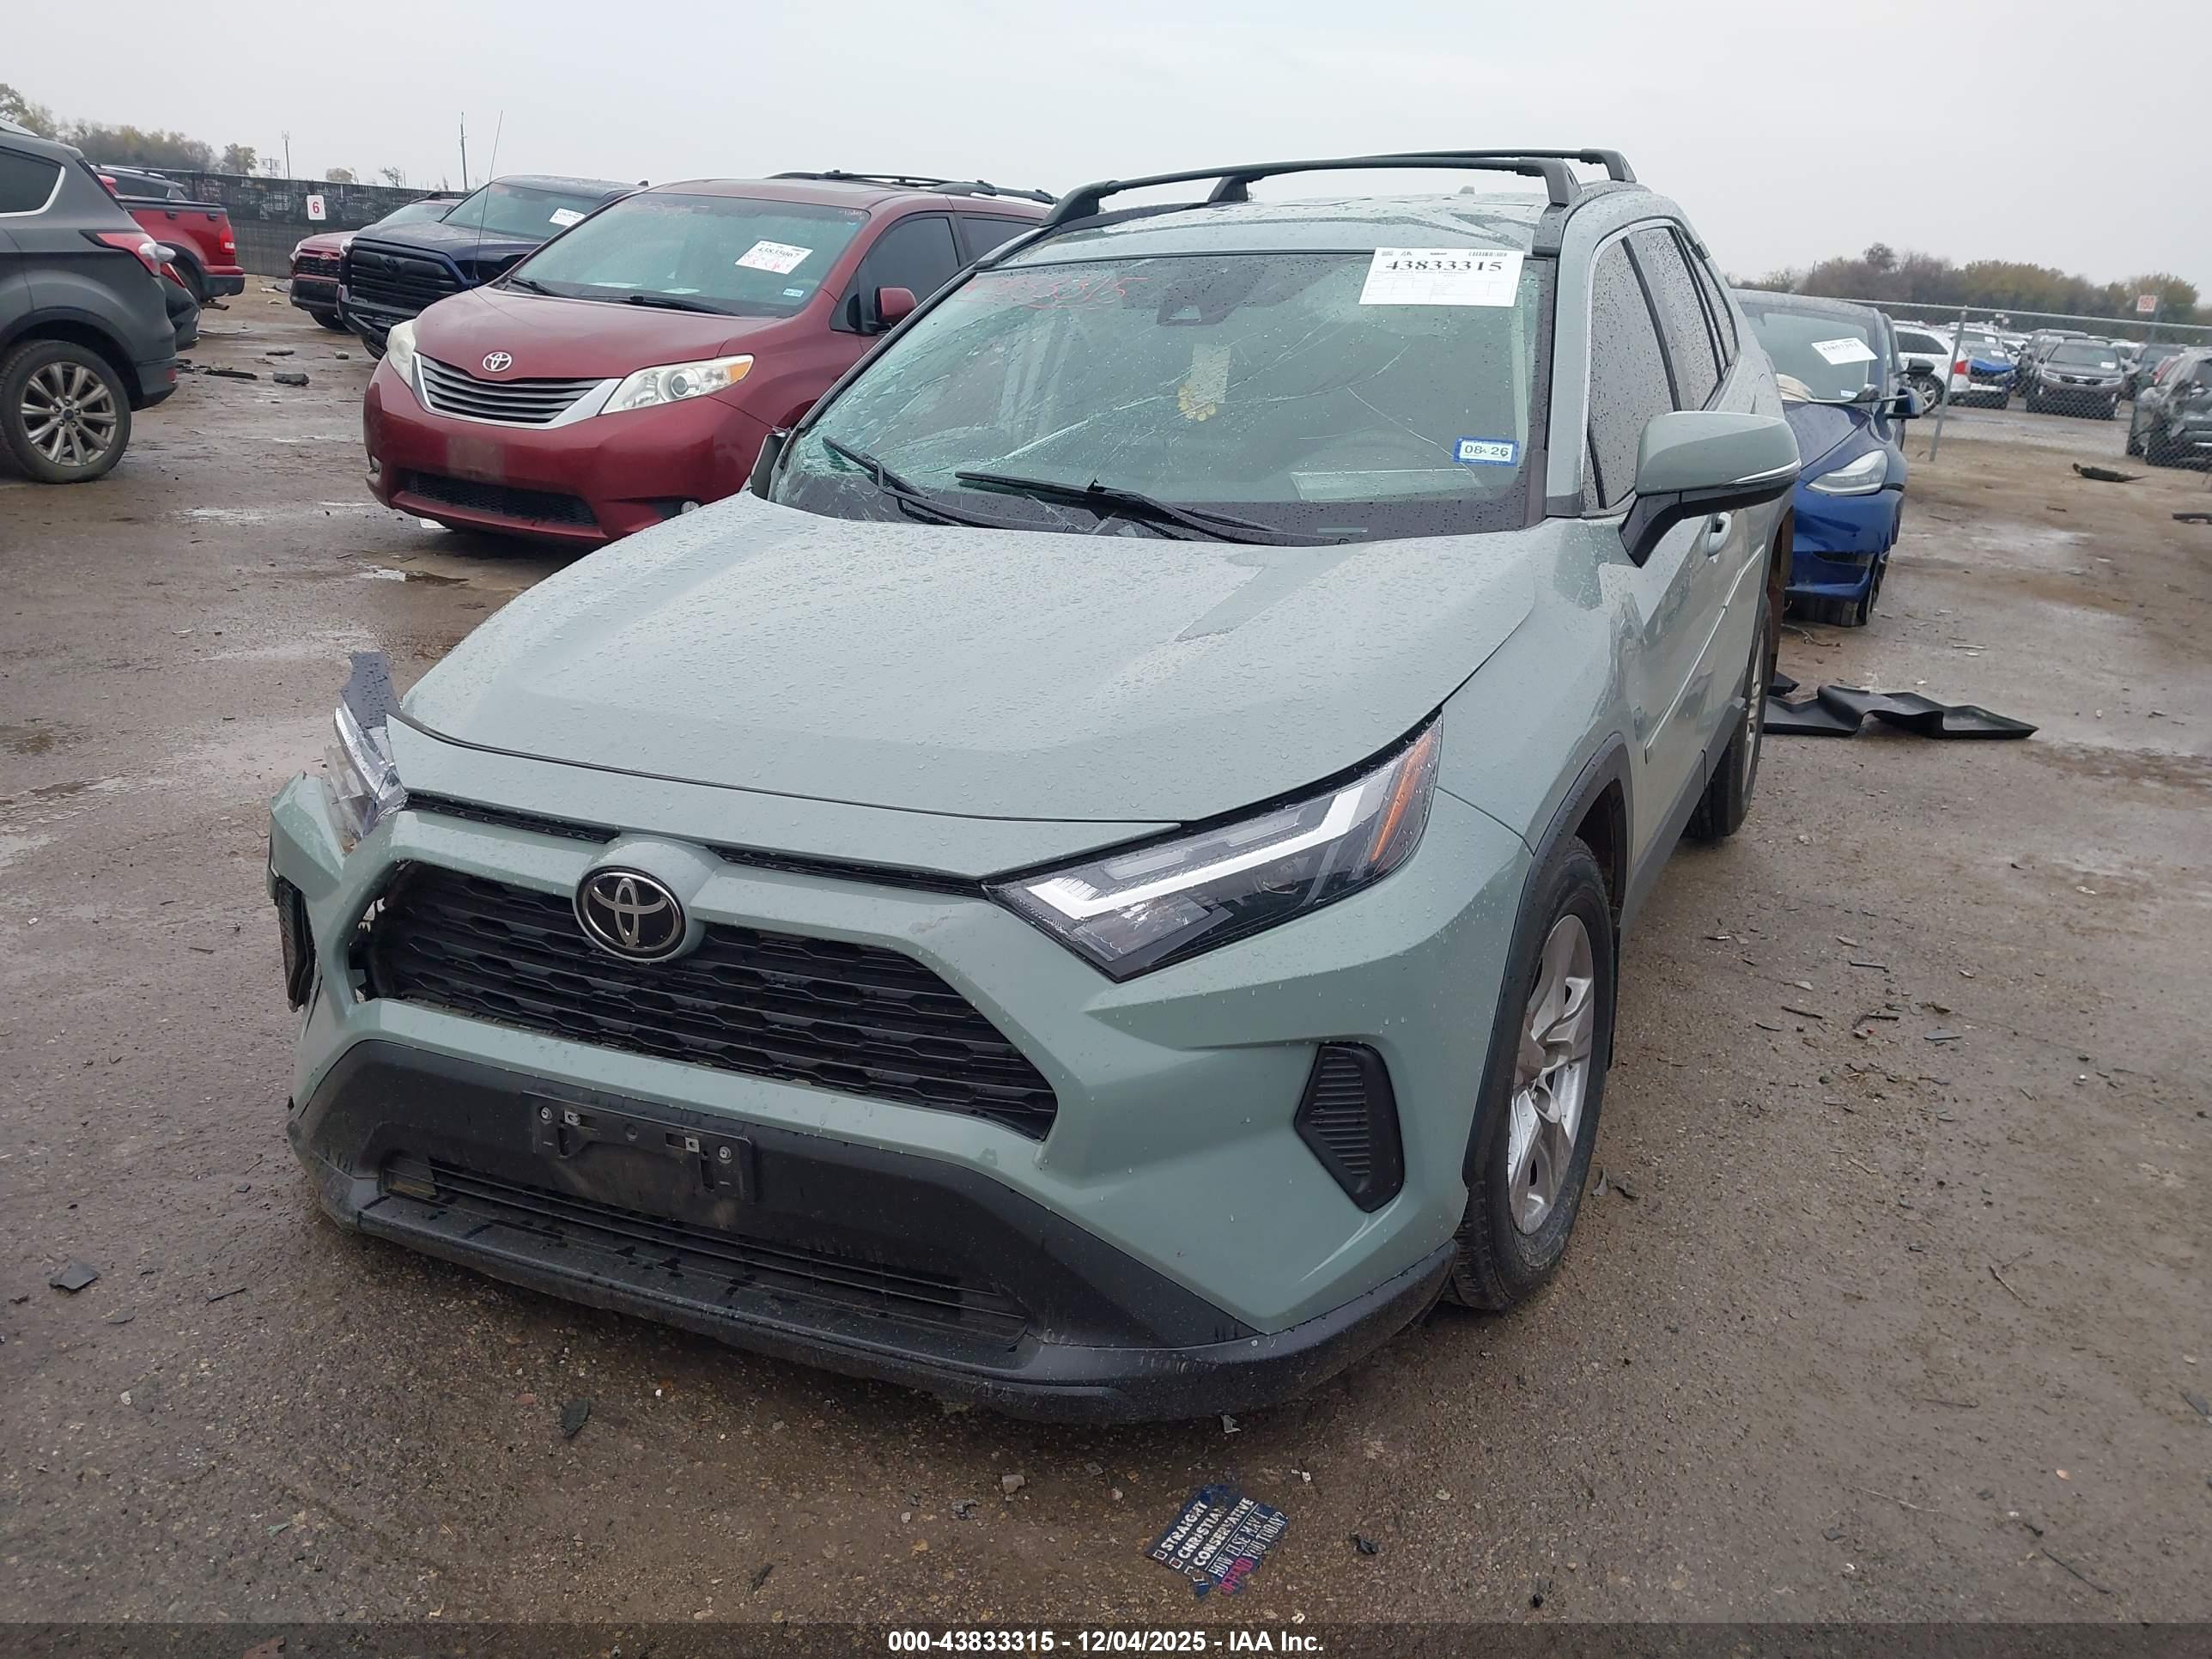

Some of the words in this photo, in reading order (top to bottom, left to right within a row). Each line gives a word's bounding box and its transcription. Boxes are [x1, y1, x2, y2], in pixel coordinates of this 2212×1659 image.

[312, 201, 320, 214] 6
[1385, 260, 1503, 272] 43833315
[1490, 447, 1510, 457] 26
[1161, 1500, 1208, 1552] STRAIGHT
[1193, 1497, 1254, 1565] CONSERVATIVE
[1208, 1553, 1234, 1577] HOW
[1224, 1533, 1251, 1557] ELSE
[1239, 1515, 1261, 1537] MAY
[1253, 1511, 1268, 1520] I
[1242, 1540, 1267, 1560] YOU
[1255, 1510, 1288, 1543] TODAY?
